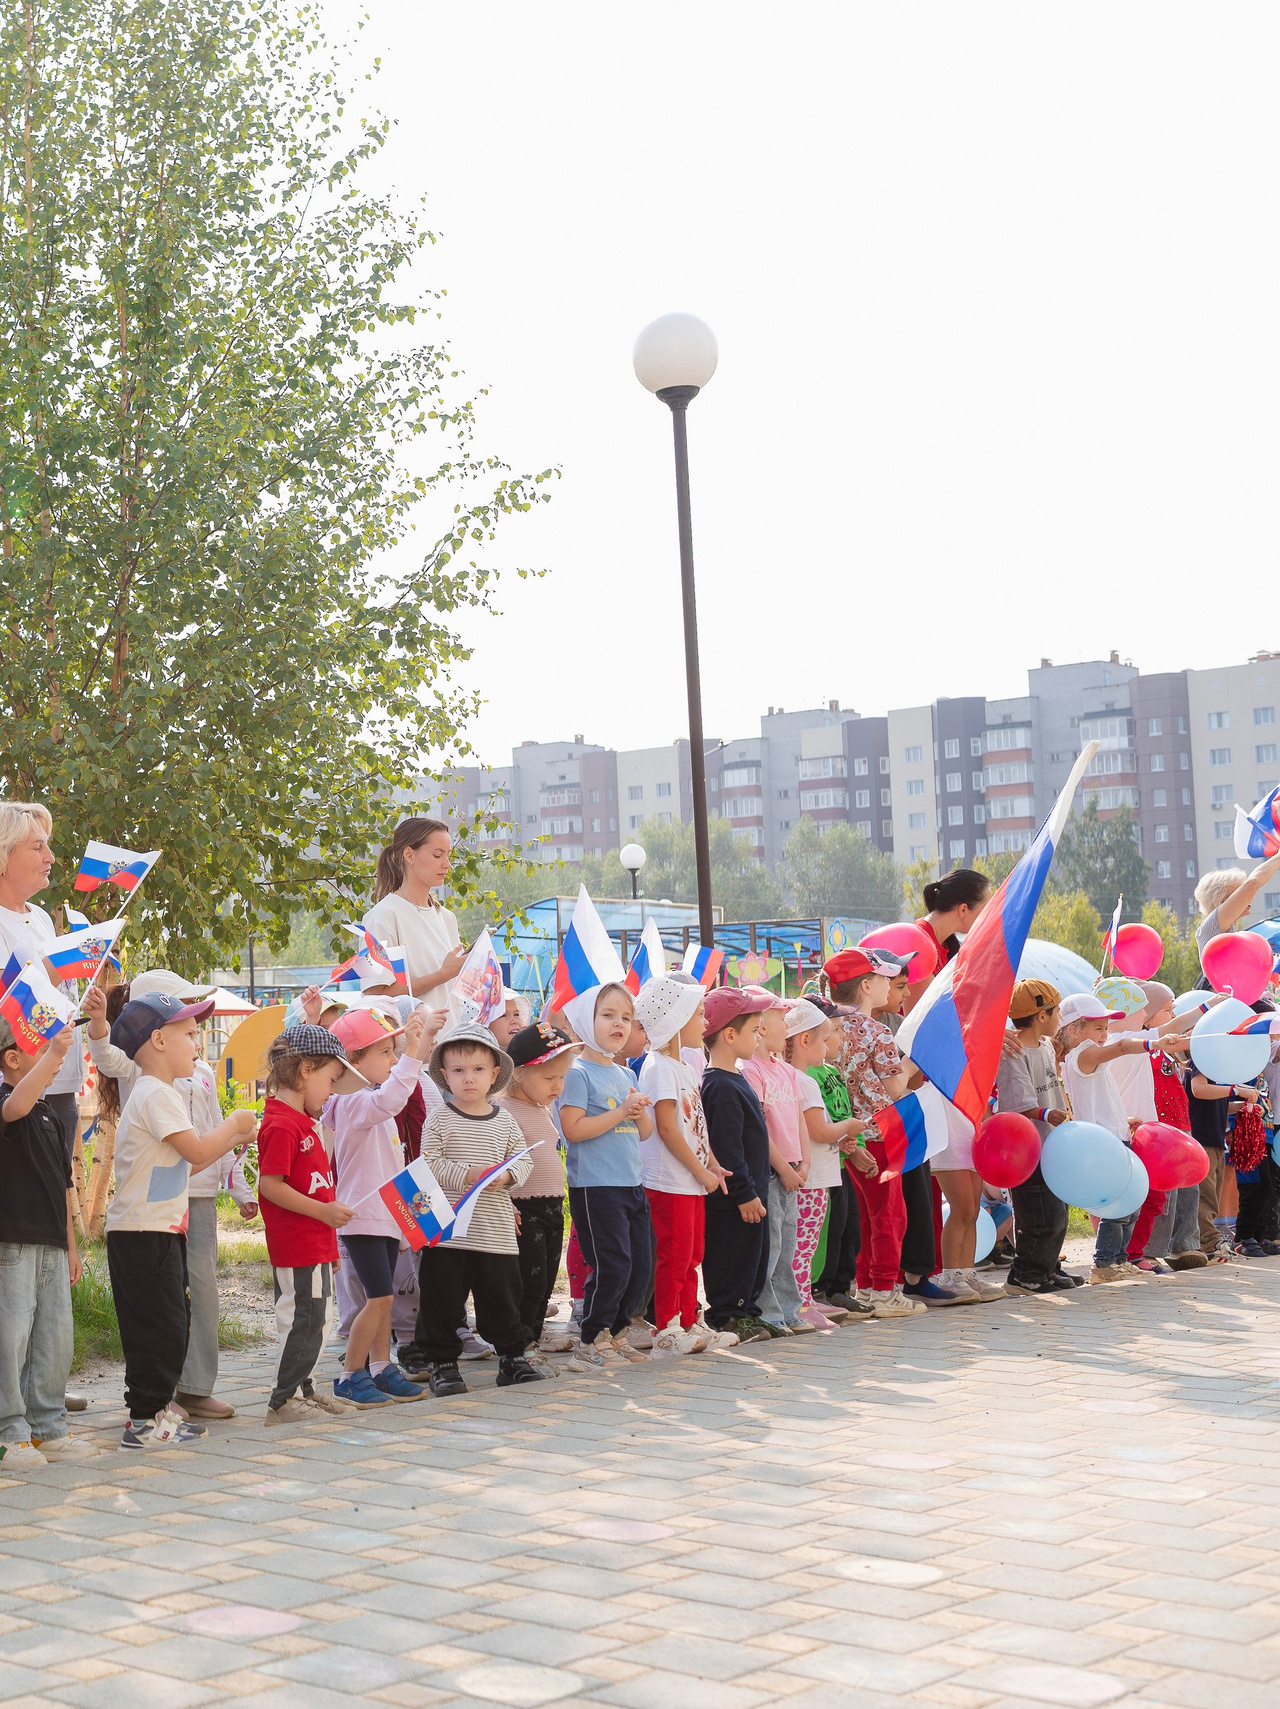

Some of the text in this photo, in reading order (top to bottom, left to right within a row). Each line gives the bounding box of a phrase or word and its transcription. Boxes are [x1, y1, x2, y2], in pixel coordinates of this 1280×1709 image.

[16, 1016, 41, 1046] РОССИ
[308, 1170, 334, 1195] AU
[394, 1199, 417, 1230] РОССИЯ
